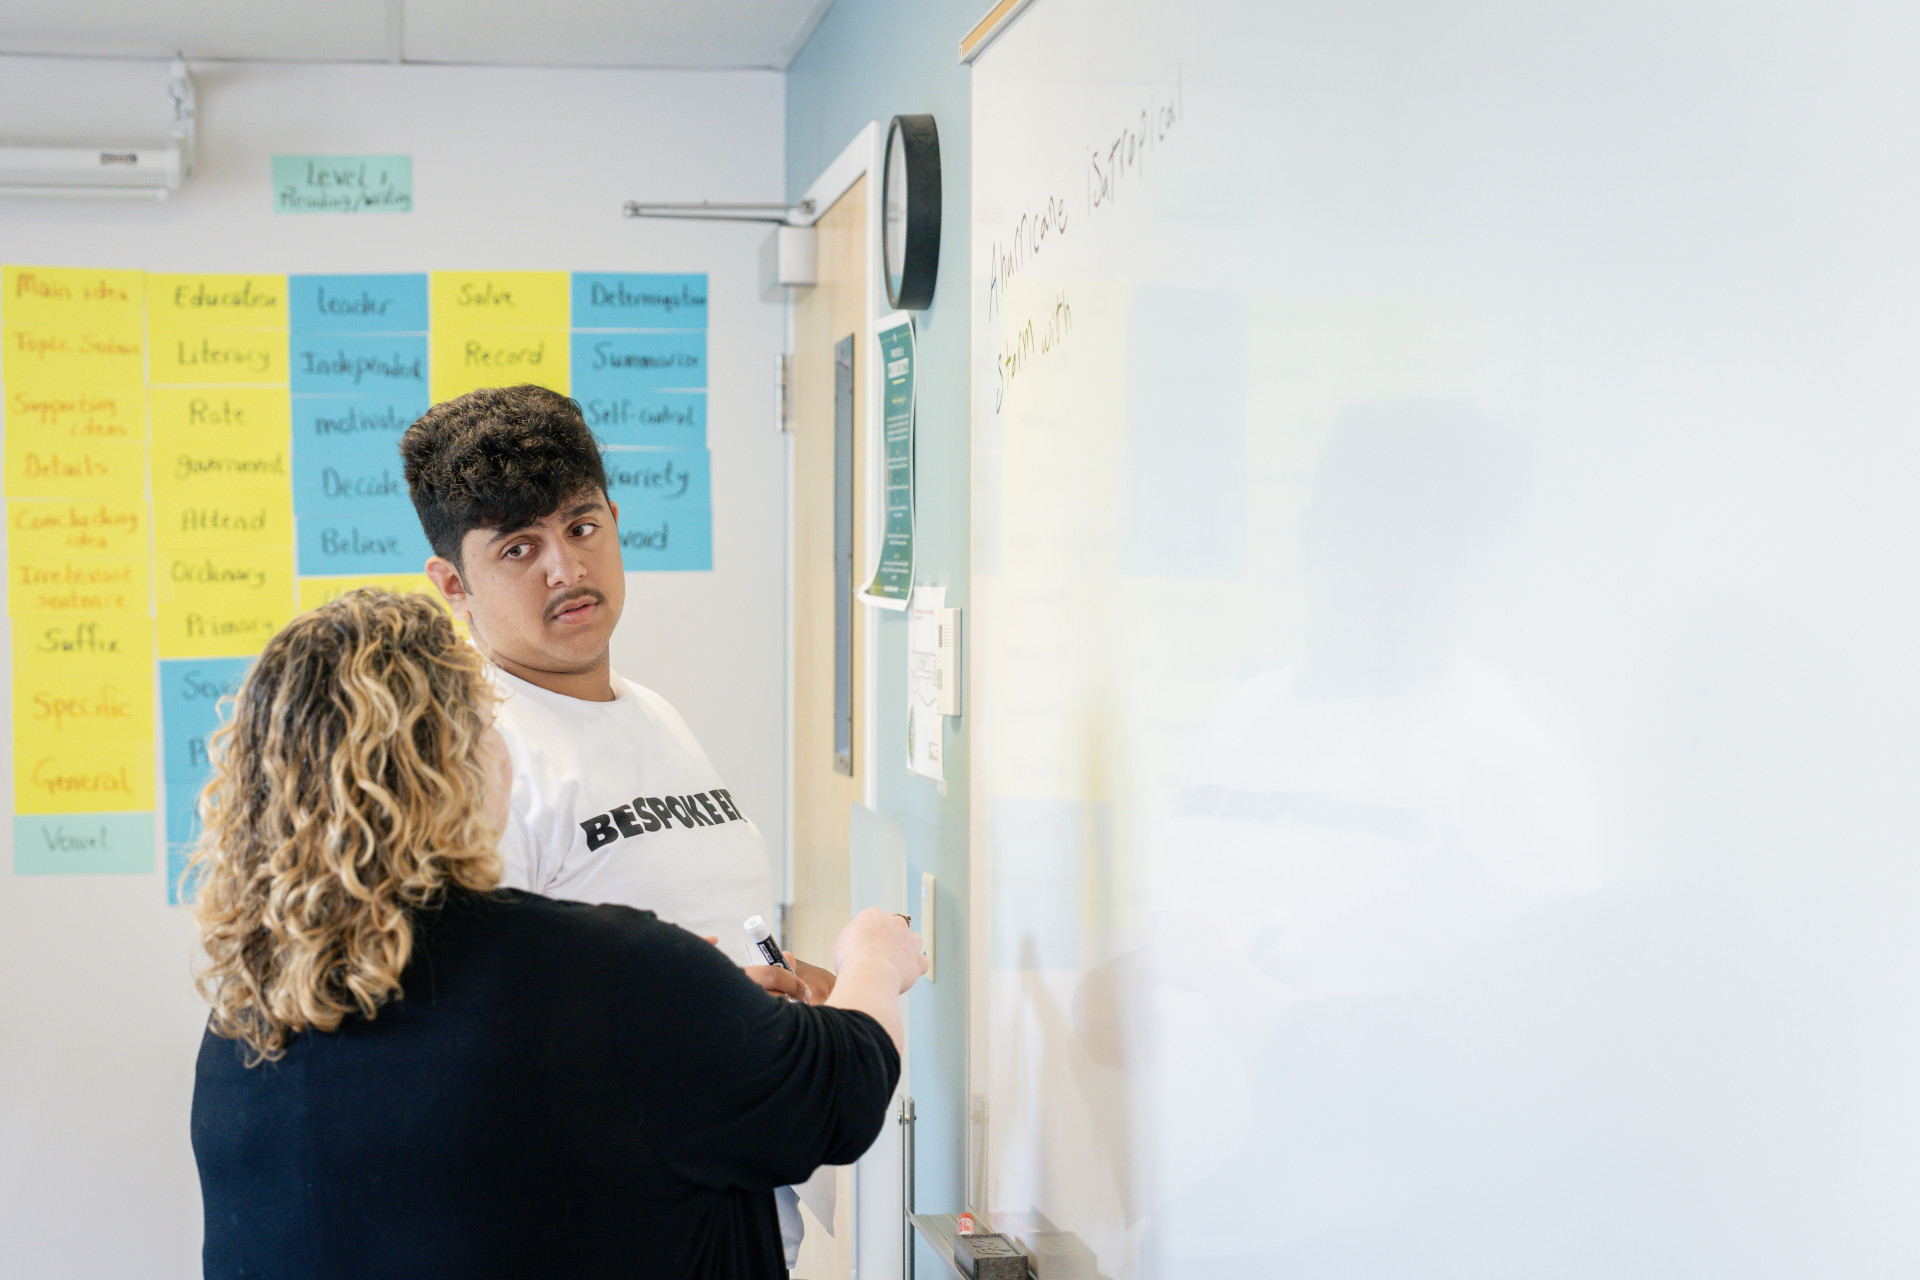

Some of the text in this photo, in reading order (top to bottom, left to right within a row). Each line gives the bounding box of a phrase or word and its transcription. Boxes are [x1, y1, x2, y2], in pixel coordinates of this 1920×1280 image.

[16, 273, 72, 300] Main
[458, 281, 516, 308] Solve
[177, 337, 271, 373] Literacy
[463, 339, 546, 368] Record
[24, 452, 108, 478] Details
[181, 507, 268, 532] Attend
[319, 527, 402, 555] Believe
[37, 621, 121, 653] Suffix
[31, 756, 134, 795] General
[40, 824, 111, 852] Vowel
